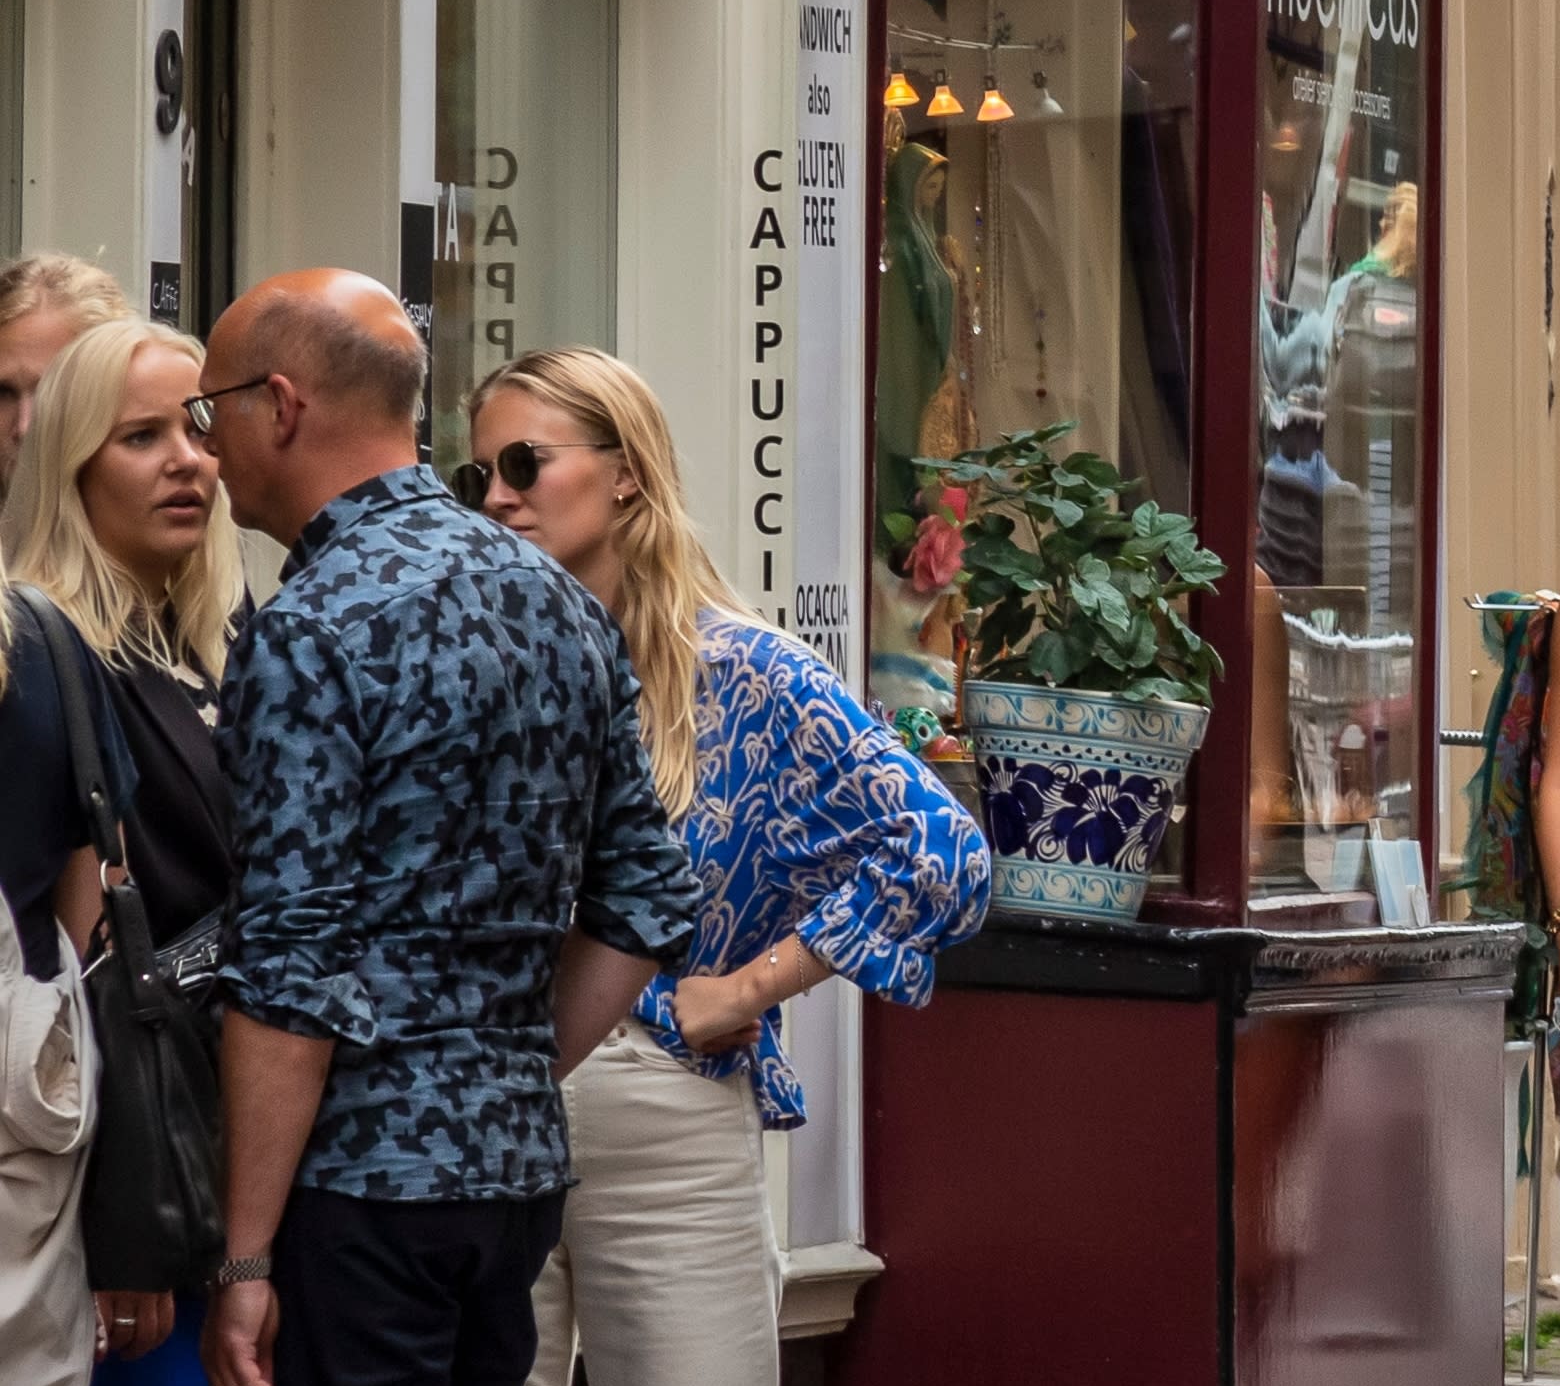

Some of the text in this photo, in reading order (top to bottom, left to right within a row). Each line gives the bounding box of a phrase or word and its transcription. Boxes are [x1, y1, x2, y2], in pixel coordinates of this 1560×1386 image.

[155, 29, 183, 135] 9
[807, 73, 831, 115] also
[803, 195, 836, 248] FREE
